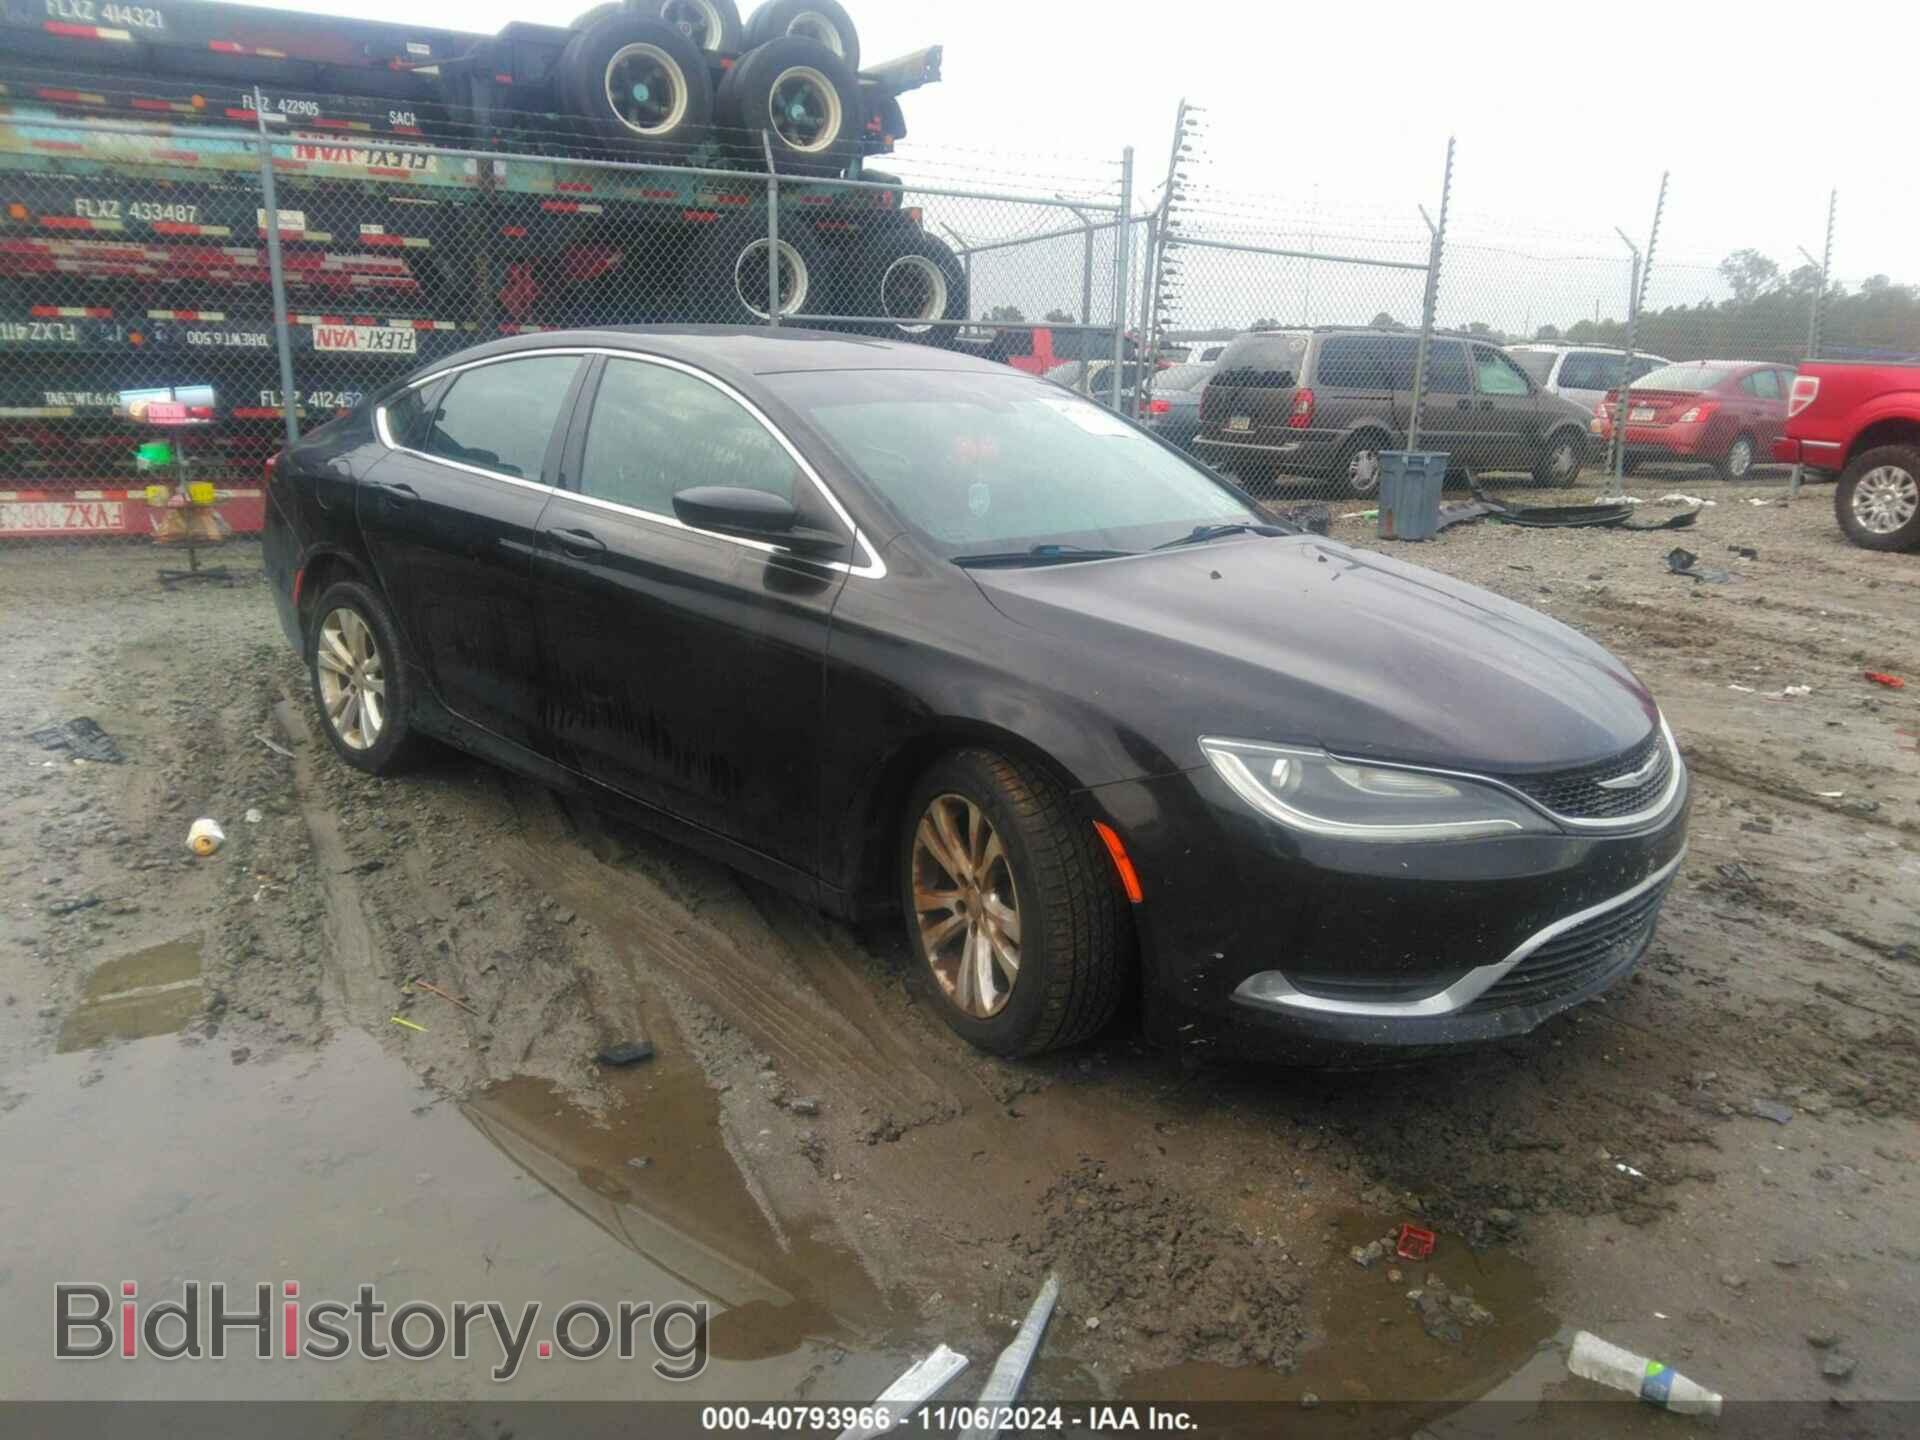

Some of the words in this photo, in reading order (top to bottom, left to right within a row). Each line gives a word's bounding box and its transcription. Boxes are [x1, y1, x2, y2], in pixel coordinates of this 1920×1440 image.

[47, 0, 96, 21] FLXZ
[101, 3, 164, 29] 414321
[241, 94, 270, 112] FLZ
[278, 98, 320, 117] 422905
[75, 198, 121, 219] FLXZ
[129, 202, 197, 223] 433487
